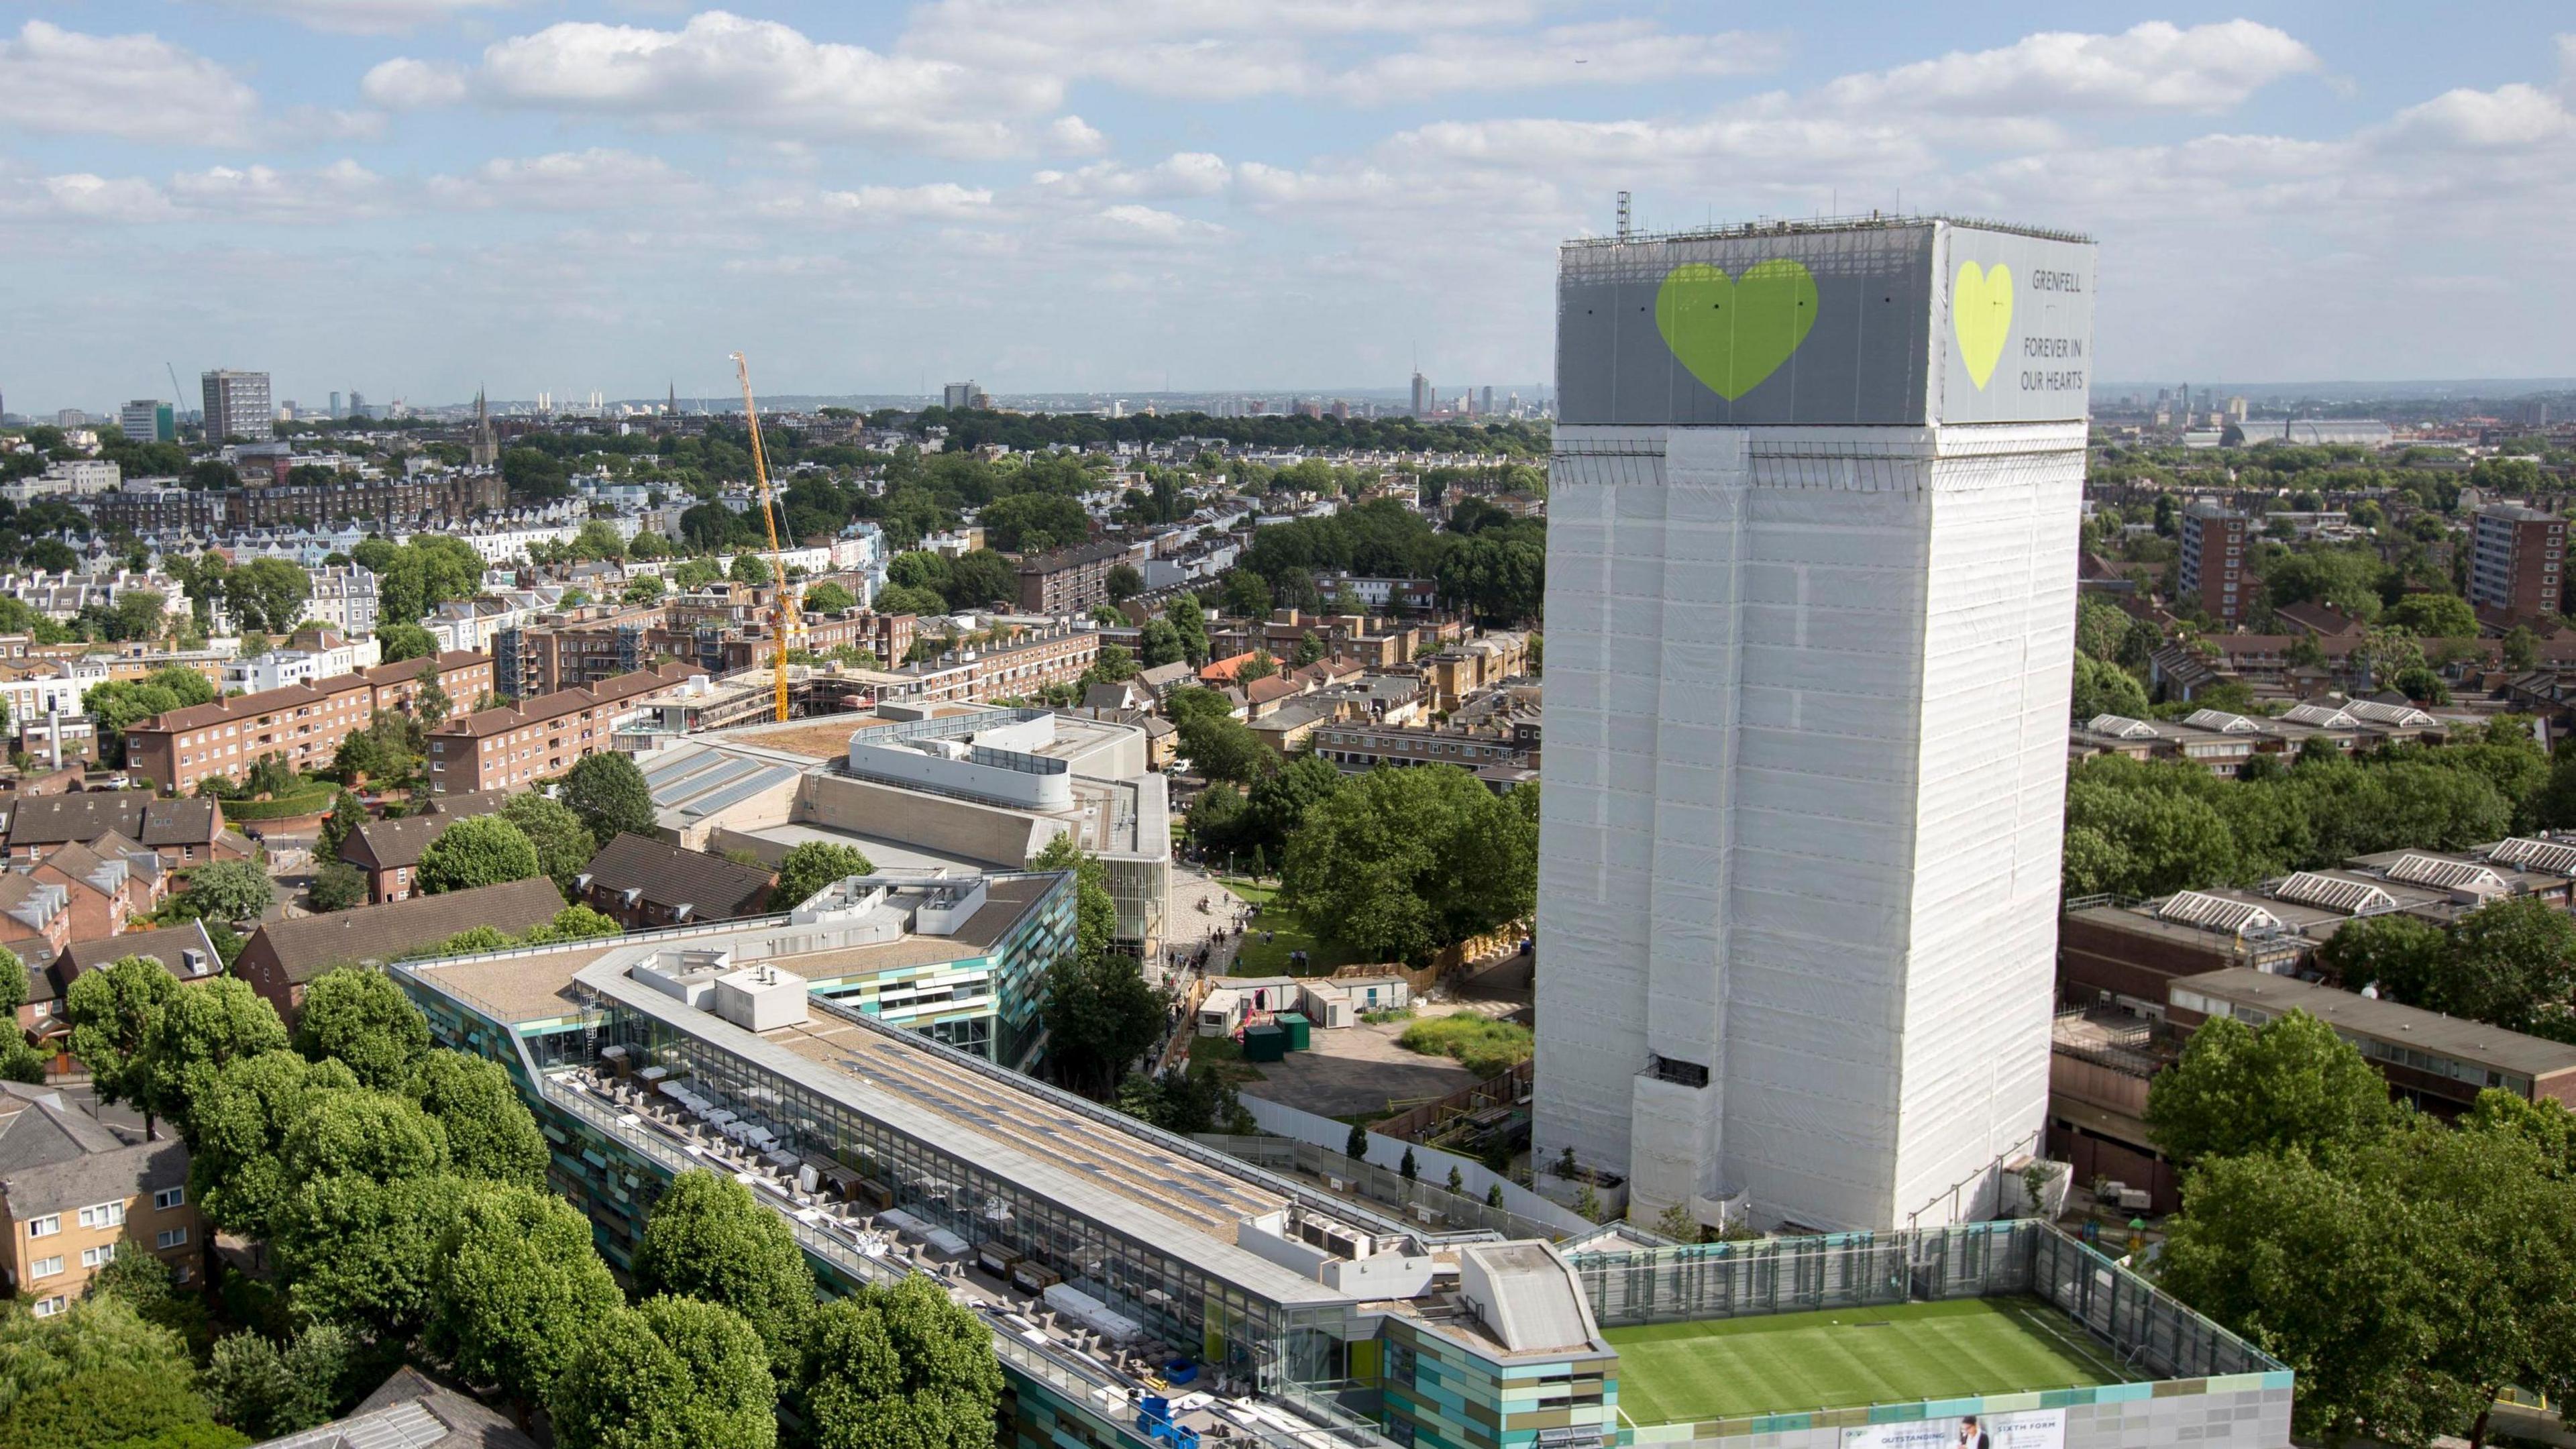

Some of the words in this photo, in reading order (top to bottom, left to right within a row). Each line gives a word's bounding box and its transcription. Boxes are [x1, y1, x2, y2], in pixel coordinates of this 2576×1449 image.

[2032, 270, 2081, 292] GRENFELL
[2024, 337, 2068, 358] FOREVER
[2071, 339, 2081, 358] IN
[2021, 371, 2044, 390] OUR
[2046, 371, 2082, 390] HEARTS
[1997, 1424, 2026, 1432] SIXTH
[2030, 1421, 2055, 1430] FORM
[1882, 1432, 1945, 1444] OUTSTANDING
